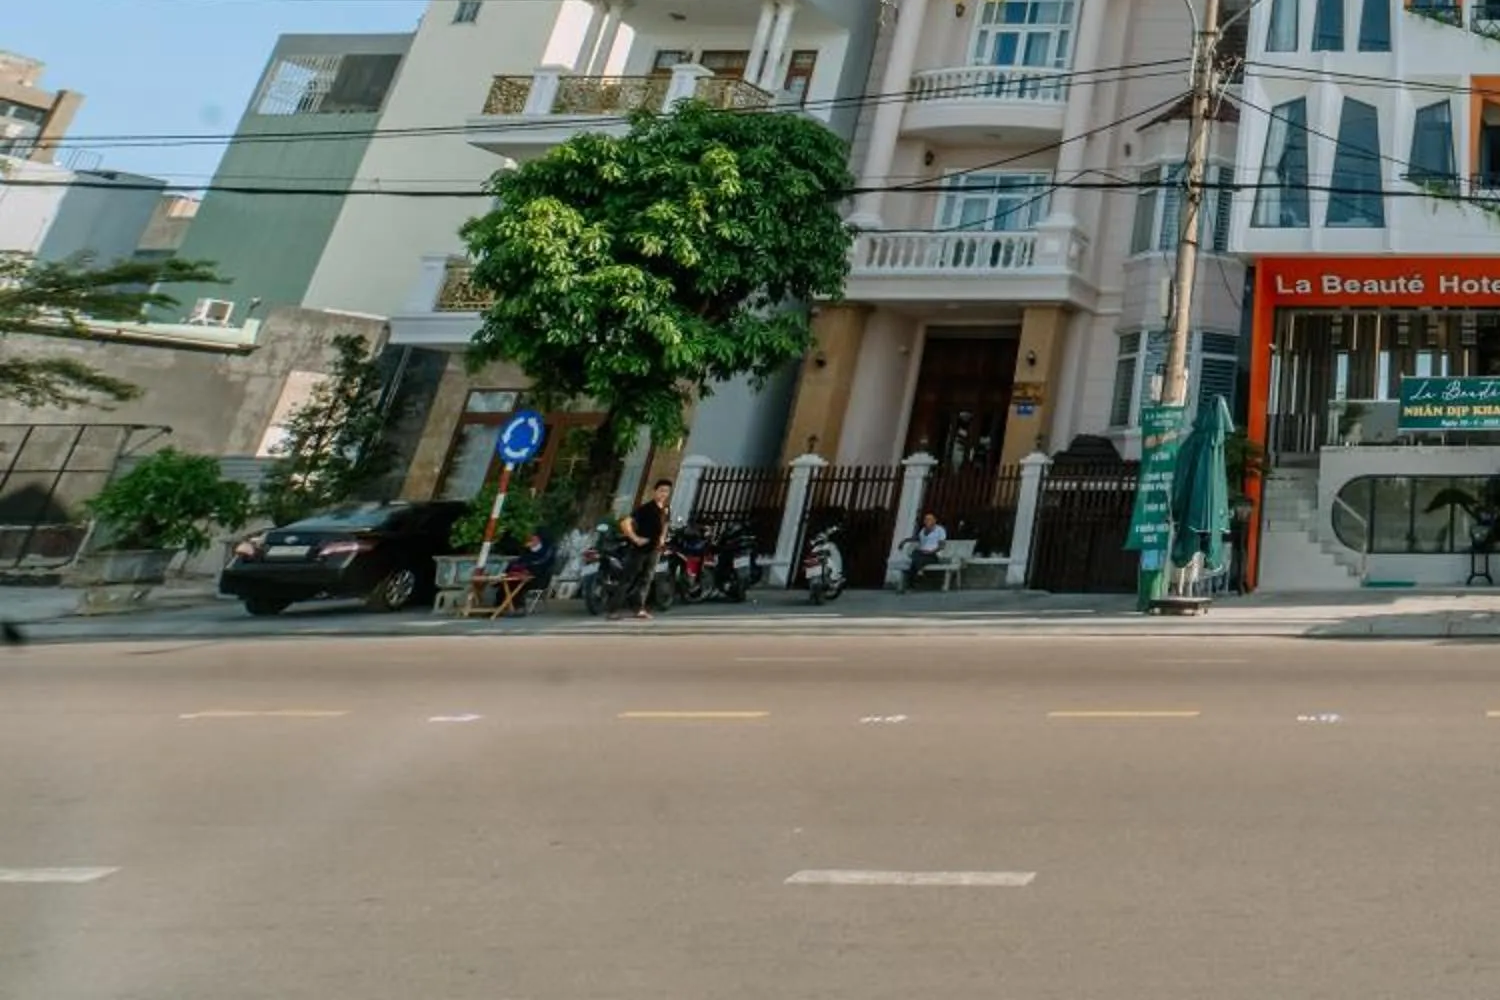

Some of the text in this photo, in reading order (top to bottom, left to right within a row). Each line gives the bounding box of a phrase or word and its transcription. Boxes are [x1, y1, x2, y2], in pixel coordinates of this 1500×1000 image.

[1276, 275, 1312, 294] La
[1322, 274, 1425, 295] Beauté
[1410, 380, 1436, 401] La
